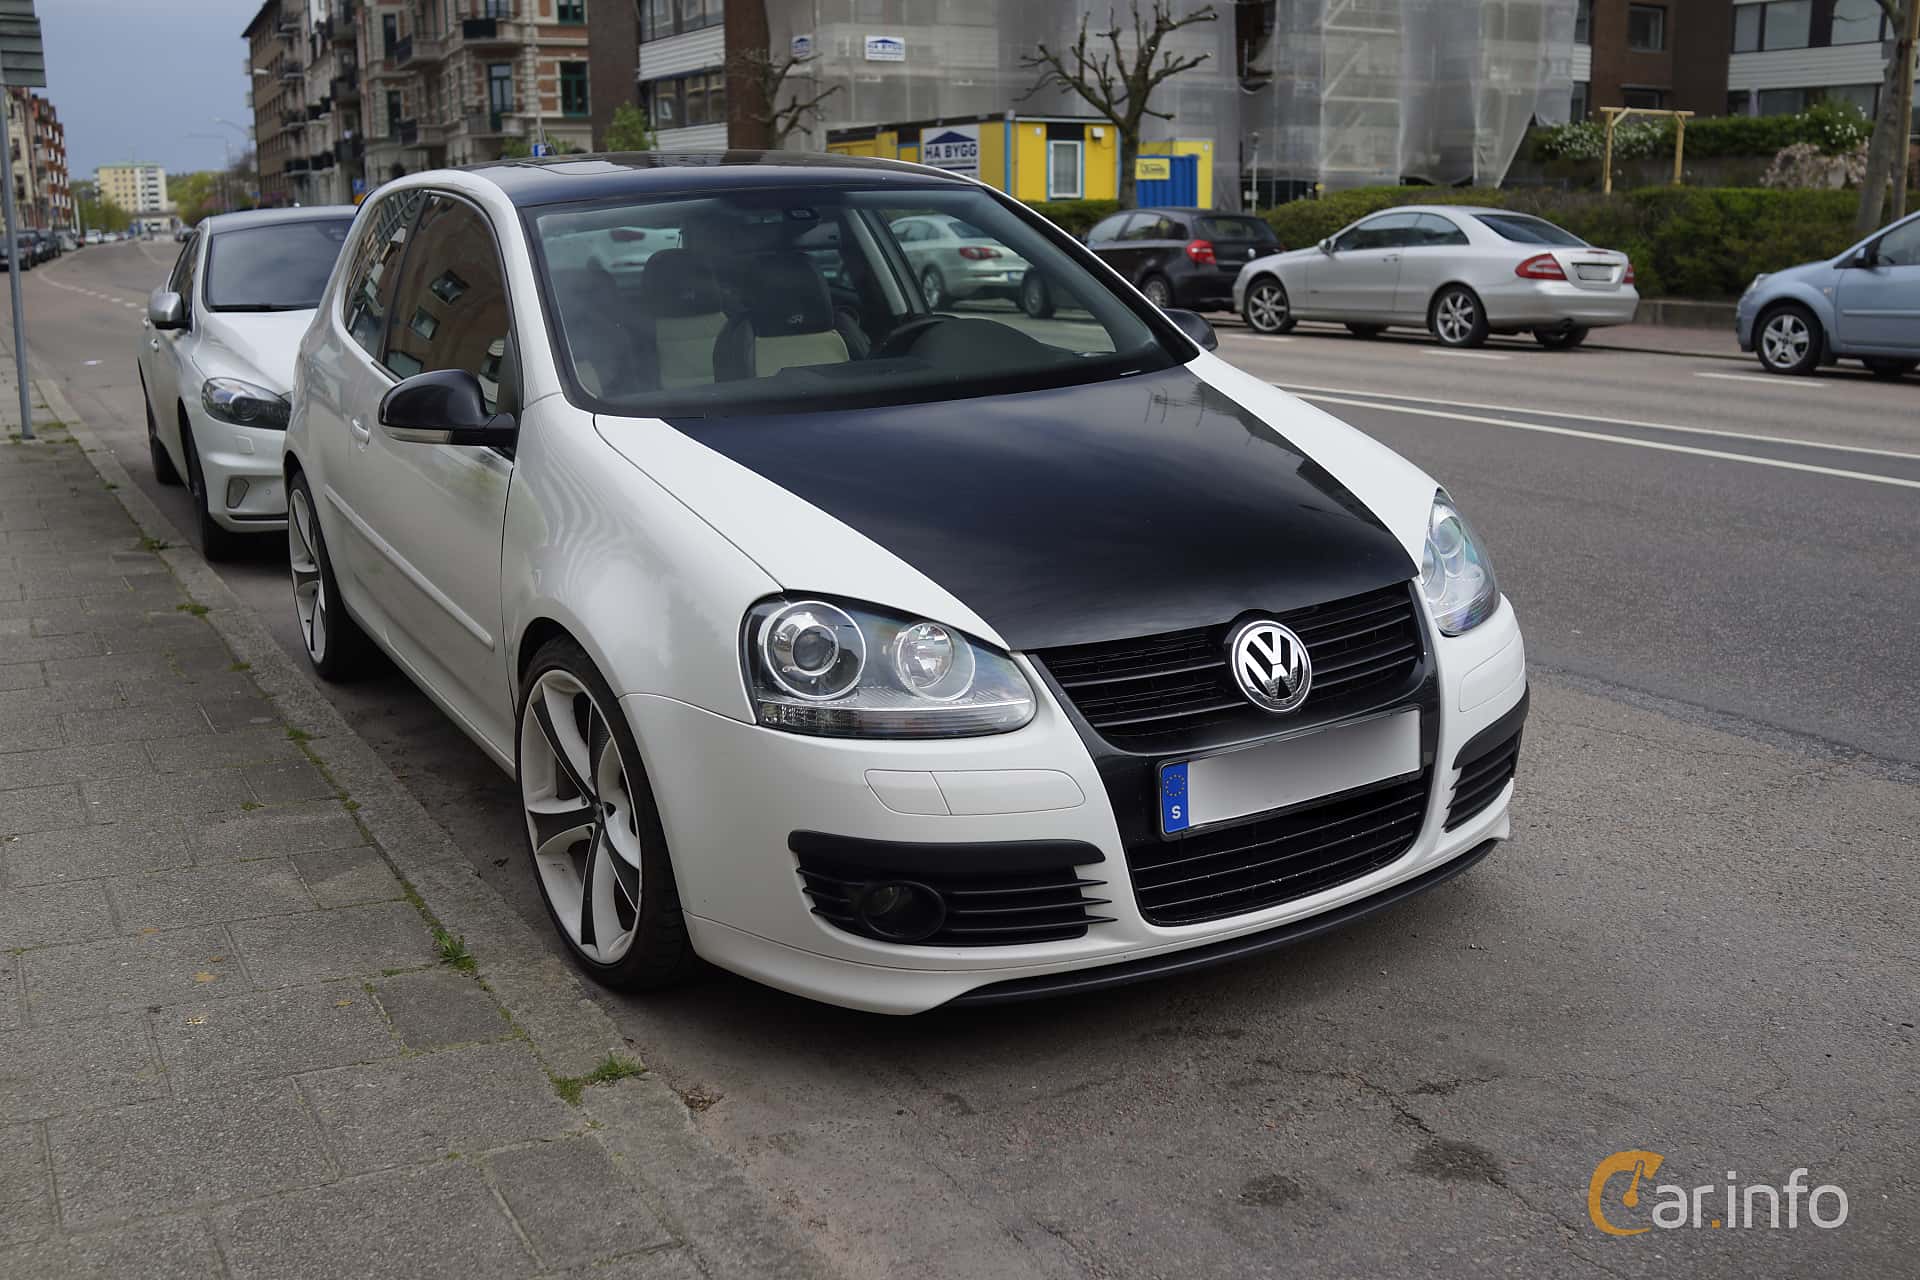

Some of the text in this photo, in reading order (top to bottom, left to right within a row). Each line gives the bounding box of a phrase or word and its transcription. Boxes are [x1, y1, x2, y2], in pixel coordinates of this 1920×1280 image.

[925, 143, 977, 159] HA BYGG
[1171, 805, 1181, 820] S
